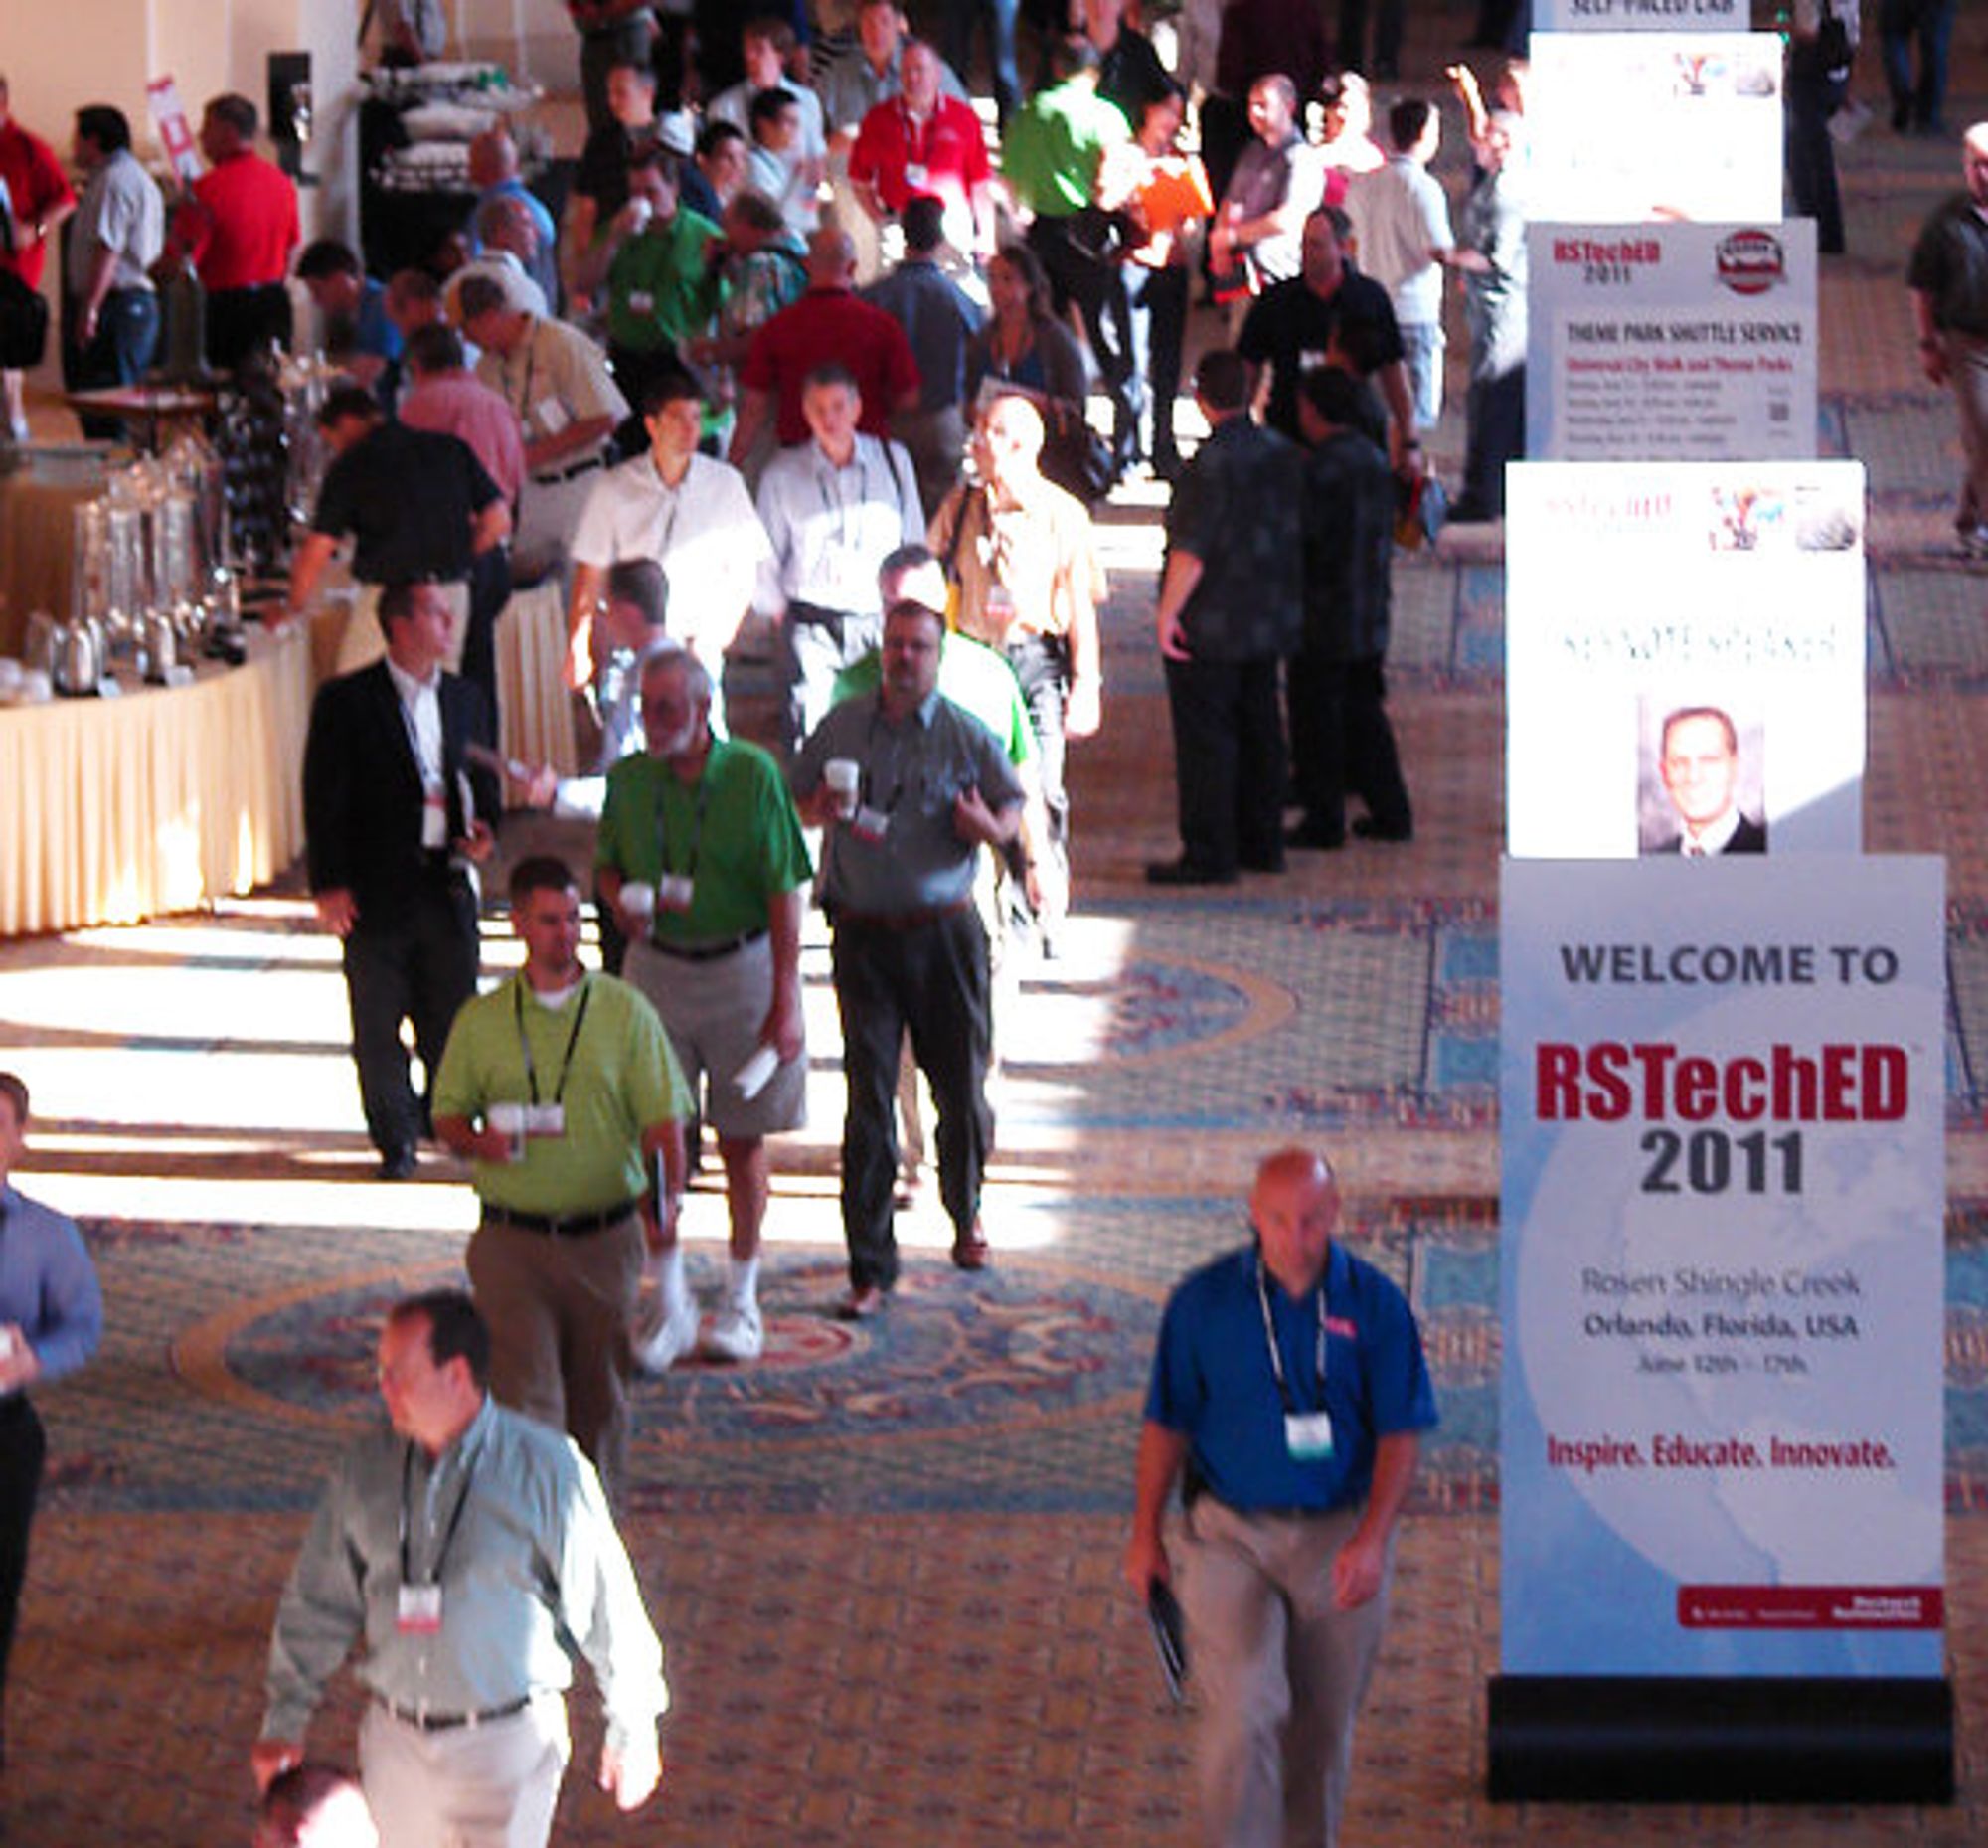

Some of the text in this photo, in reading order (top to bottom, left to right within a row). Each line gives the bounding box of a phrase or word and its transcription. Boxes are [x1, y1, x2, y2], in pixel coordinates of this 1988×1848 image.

[1583, 264, 1632, 284] 2011
[1623, 321, 1665, 344] PARK
[1560, 944, 1900, 985] WELCOME TO
[1535, 1042, 1909, 1122] RSTechED
[1639, 1128, 1804, 1195] 2011
[1582, 1267, 1860, 1300] Rosen Shingle Creek
[1584, 1311, 1860, 1339] Orlando, Florida, USA
[1638, 1353, 1686, 1374] June
[1694, 1353, 1739, 1374] 12th
[1547, 1432, 1895, 1475] Inspire. Educate. Innovate.
